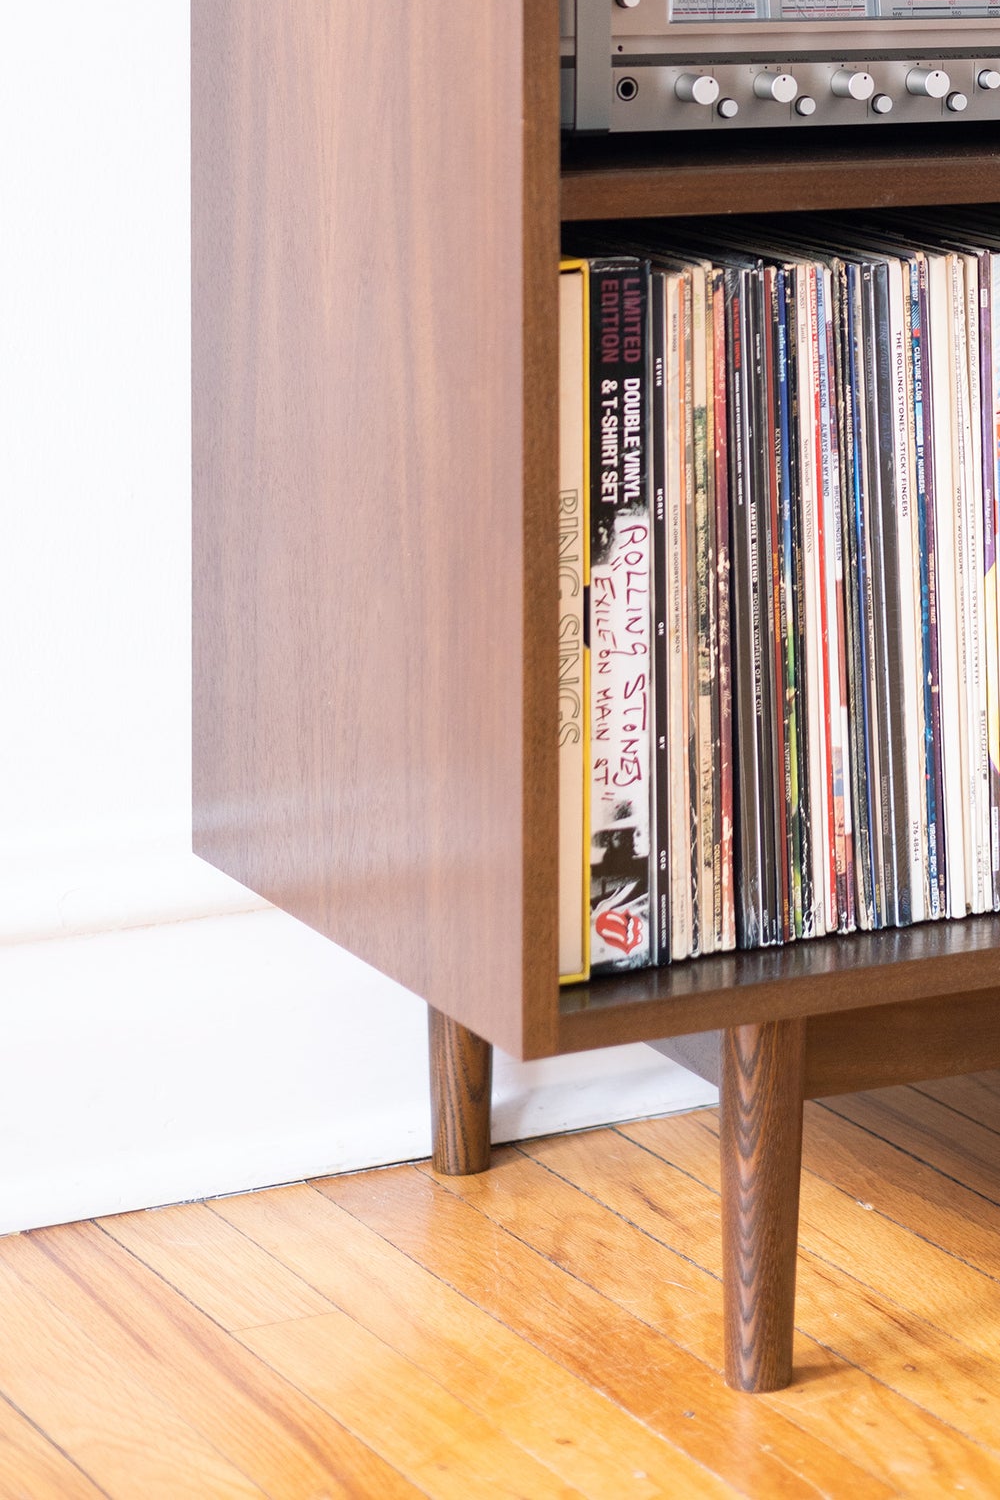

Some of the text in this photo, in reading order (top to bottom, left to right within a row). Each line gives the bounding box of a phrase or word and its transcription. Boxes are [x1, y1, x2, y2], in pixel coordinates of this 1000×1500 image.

[601, 279, 620, 363] EDITION
[623, 278, 642, 363] LIMITED
[777, 325, 786, 348] justin
[601, 380, 619, 504] & T-SHIRT SET
[622, 378, 641, 504] DOUBLE VINYL
[655, 358, 664, 520] KEVIN MORBY
[914, 347, 926, 494] CULTURE BY NUMBERS
[803, 460, 811, 487] Wonder
[822, 455, 828, 464] ON
[823, 467, 829, 477] MY
[805, 500, 813, 553] INNERVISIONS
[598, 649, 612, 674] ON
[611, 525, 648, 787] ROLLING STONES
[755, 669, 761, 679] OF
[595, 687, 613, 741] MAIN
[881, 776, 889, 804] PARTISAN
